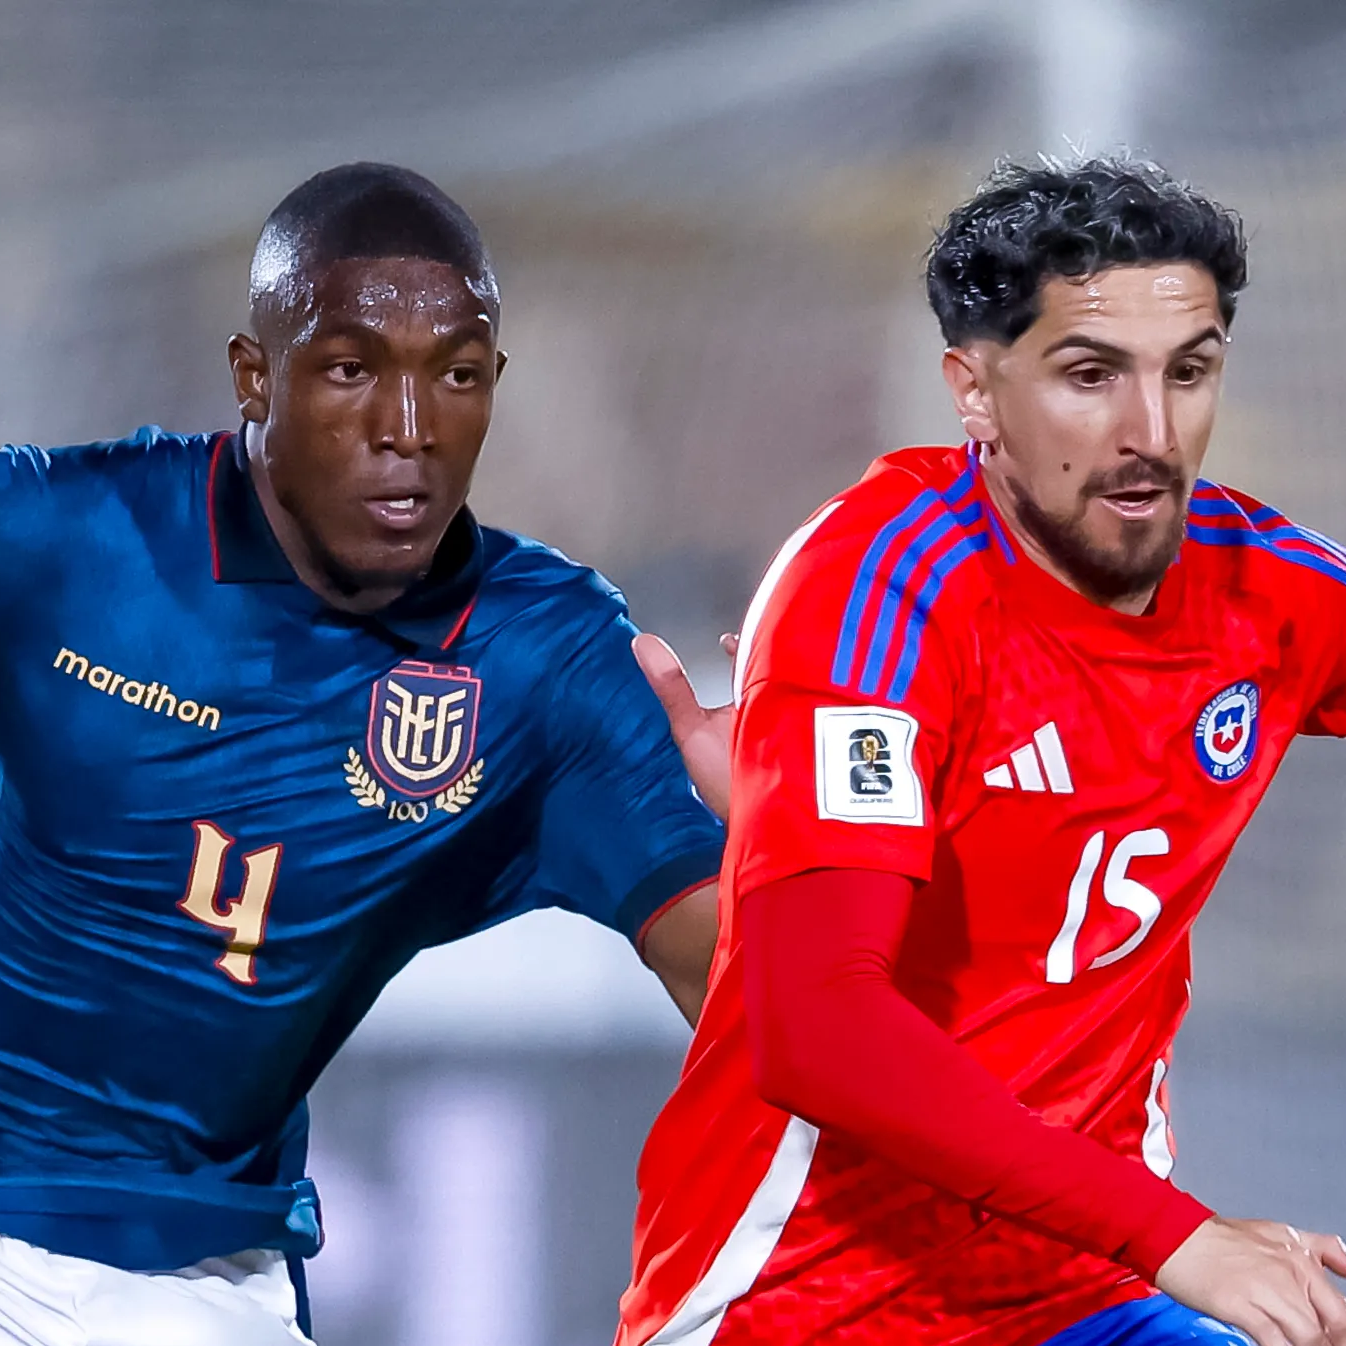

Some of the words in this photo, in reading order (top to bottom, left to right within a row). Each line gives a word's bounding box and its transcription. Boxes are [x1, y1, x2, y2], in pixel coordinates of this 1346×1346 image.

[53, 647, 221, 731] marathon
[387, 800, 430, 823] 100
[176, 819, 283, 985] 4
[1045, 827, 1171, 984] 15
